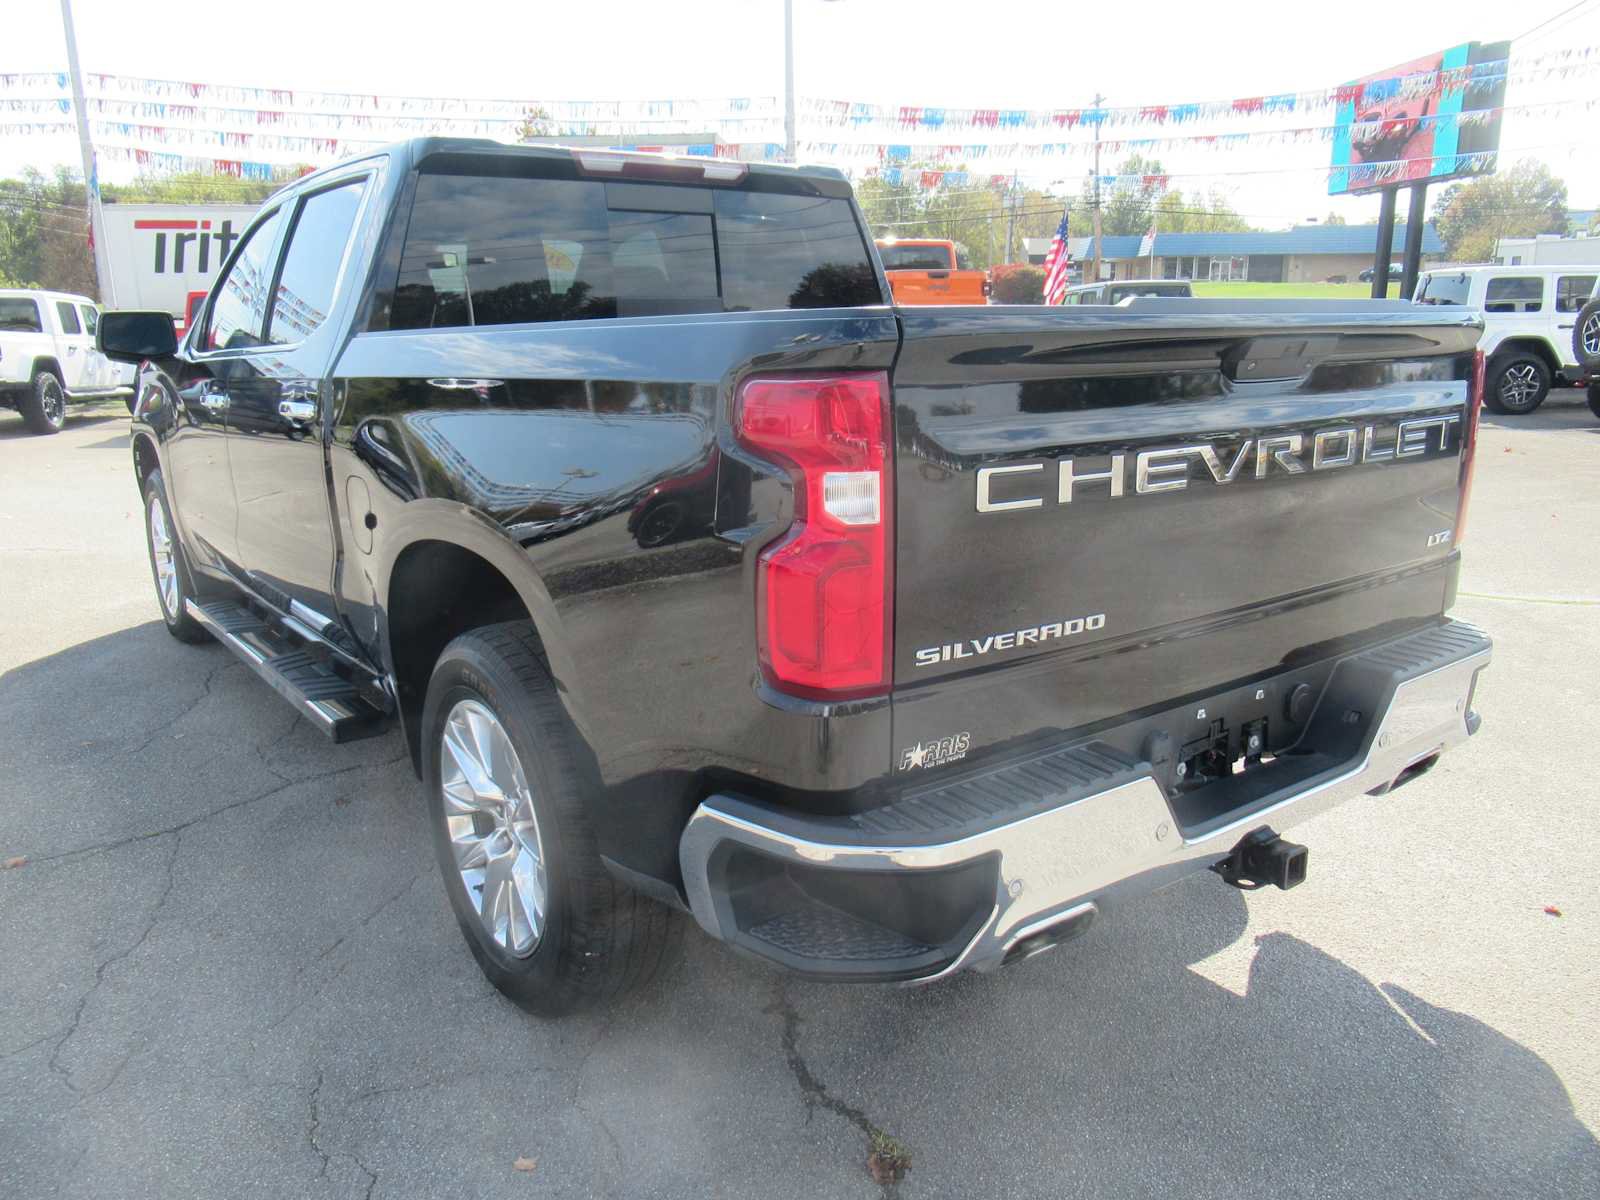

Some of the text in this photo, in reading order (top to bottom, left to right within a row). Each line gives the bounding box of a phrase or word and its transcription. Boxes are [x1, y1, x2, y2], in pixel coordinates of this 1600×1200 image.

[975, 414, 1459, 513] CHEVROLET
[1427, 529, 1450, 547] LTZ
[915, 613, 1106, 667] SILVERADO
